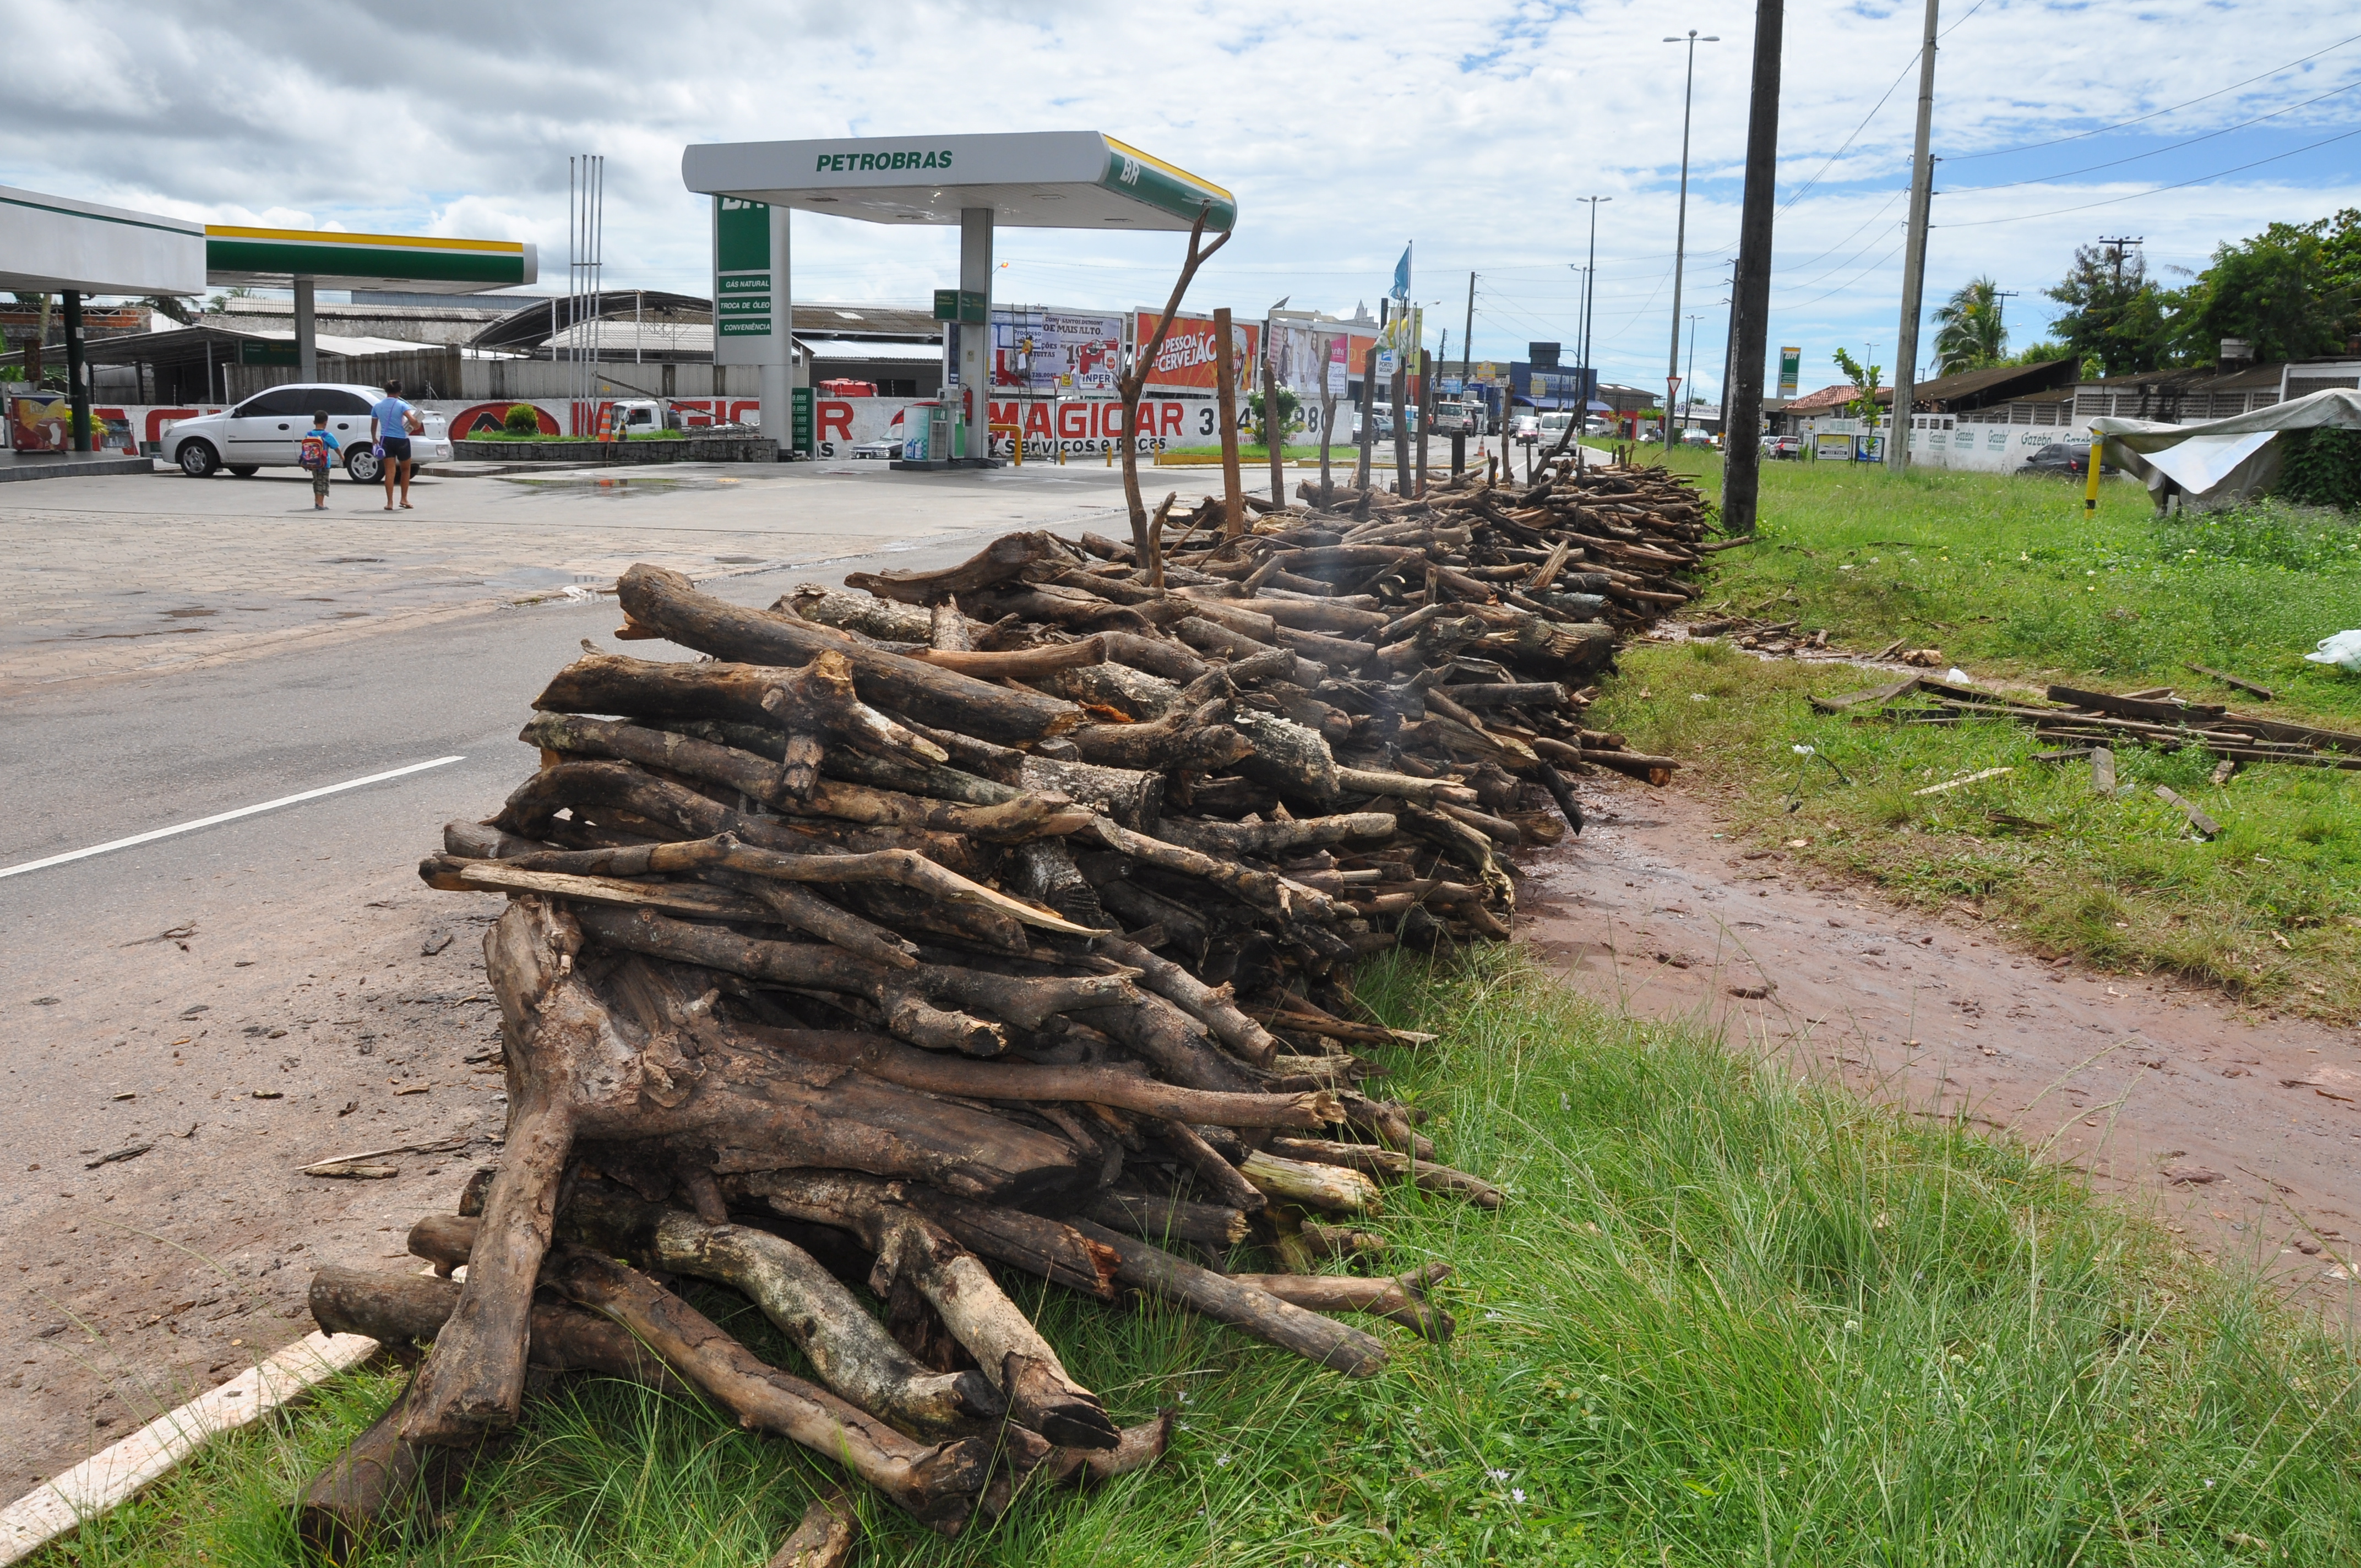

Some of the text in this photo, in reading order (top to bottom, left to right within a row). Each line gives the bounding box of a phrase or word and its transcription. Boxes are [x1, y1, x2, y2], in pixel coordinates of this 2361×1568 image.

[816, 150, 953, 172] PETROBRAS
[1119, 156, 1140, 186] BR
[753, 300, 770, 308] ÓLEO
[724, 322, 770, 331] CONVENIÊNCIA
[1057, 325, 1078, 334] MAIS
[1079, 327, 1103, 335] ALTO.
[1165, 333, 1198, 353] PESSOA
[989, 402, 1184, 439] MAGICAR
[1101, 439, 1111, 451] e
